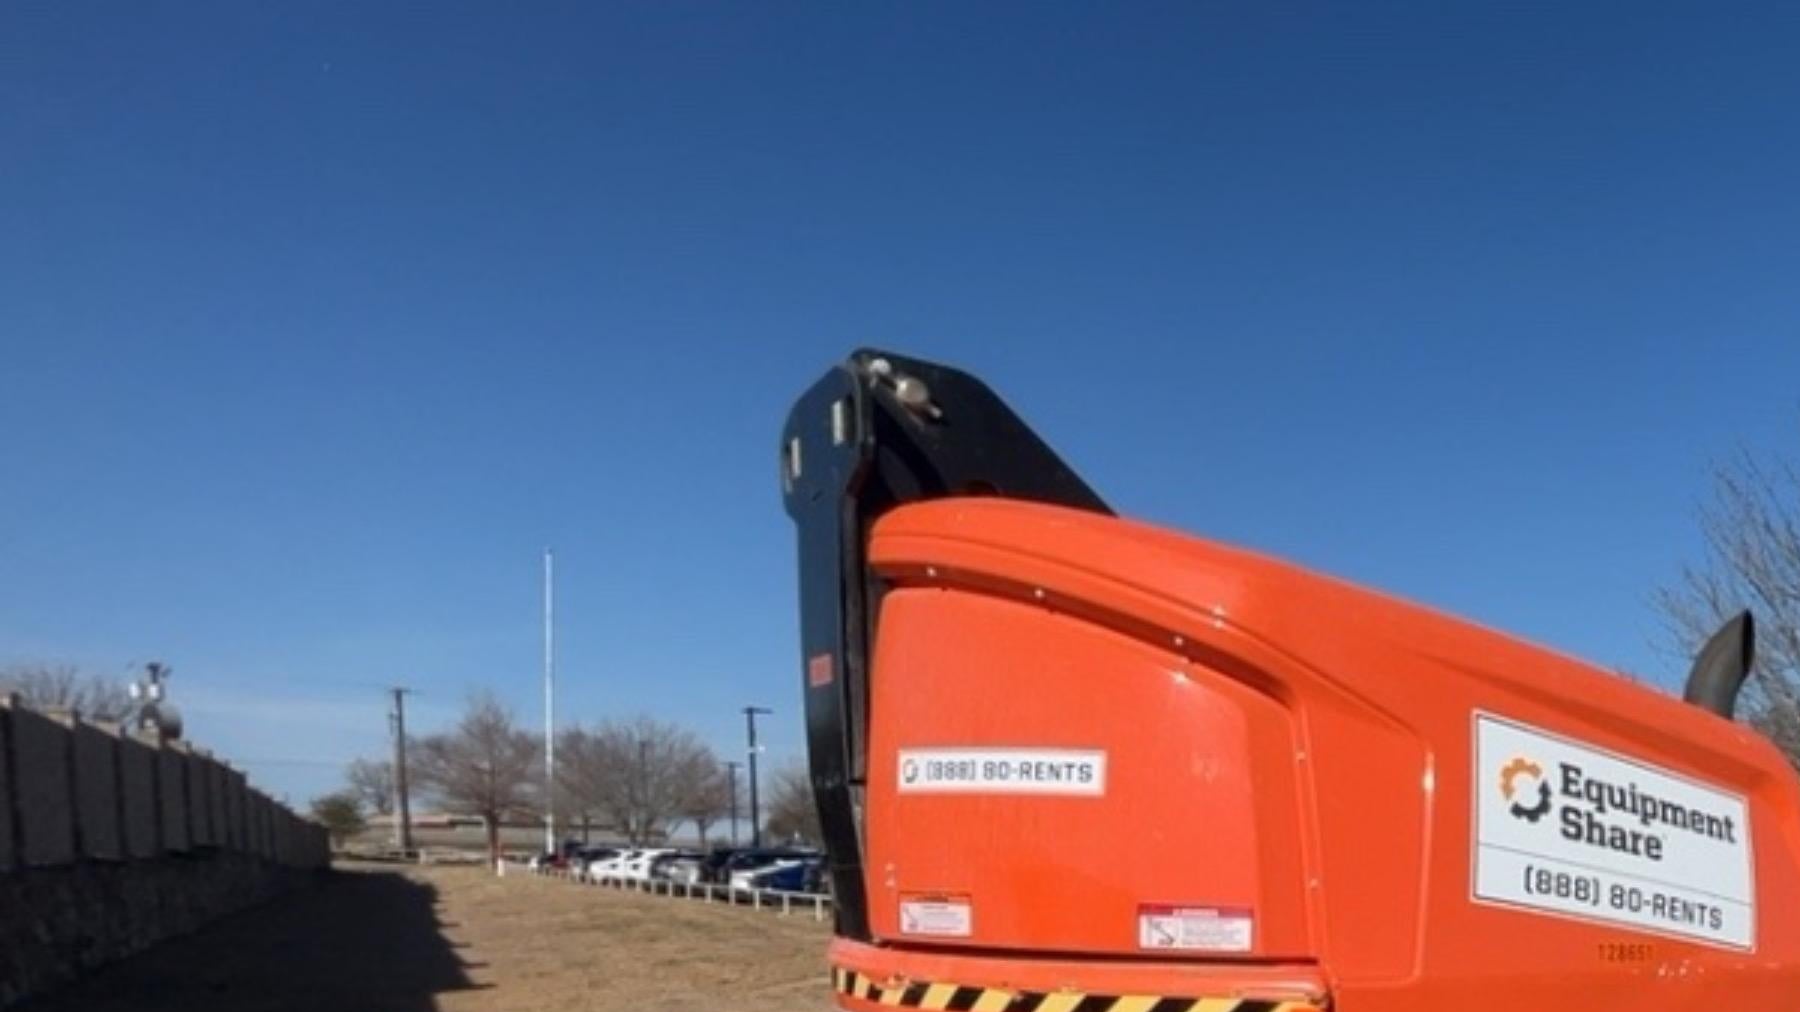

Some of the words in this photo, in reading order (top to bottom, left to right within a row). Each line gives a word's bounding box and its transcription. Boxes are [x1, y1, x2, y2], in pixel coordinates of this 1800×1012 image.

[926, 759, 976, 781] (888)
[983, 761, 1093, 783] 80-RENTS
[1558, 762, 1736, 844] Equipment
[1560, 804, 1664, 861] Share
[1524, 865, 1600, 906] (888)
[1609, 884, 1723, 930] 80-RENTS
